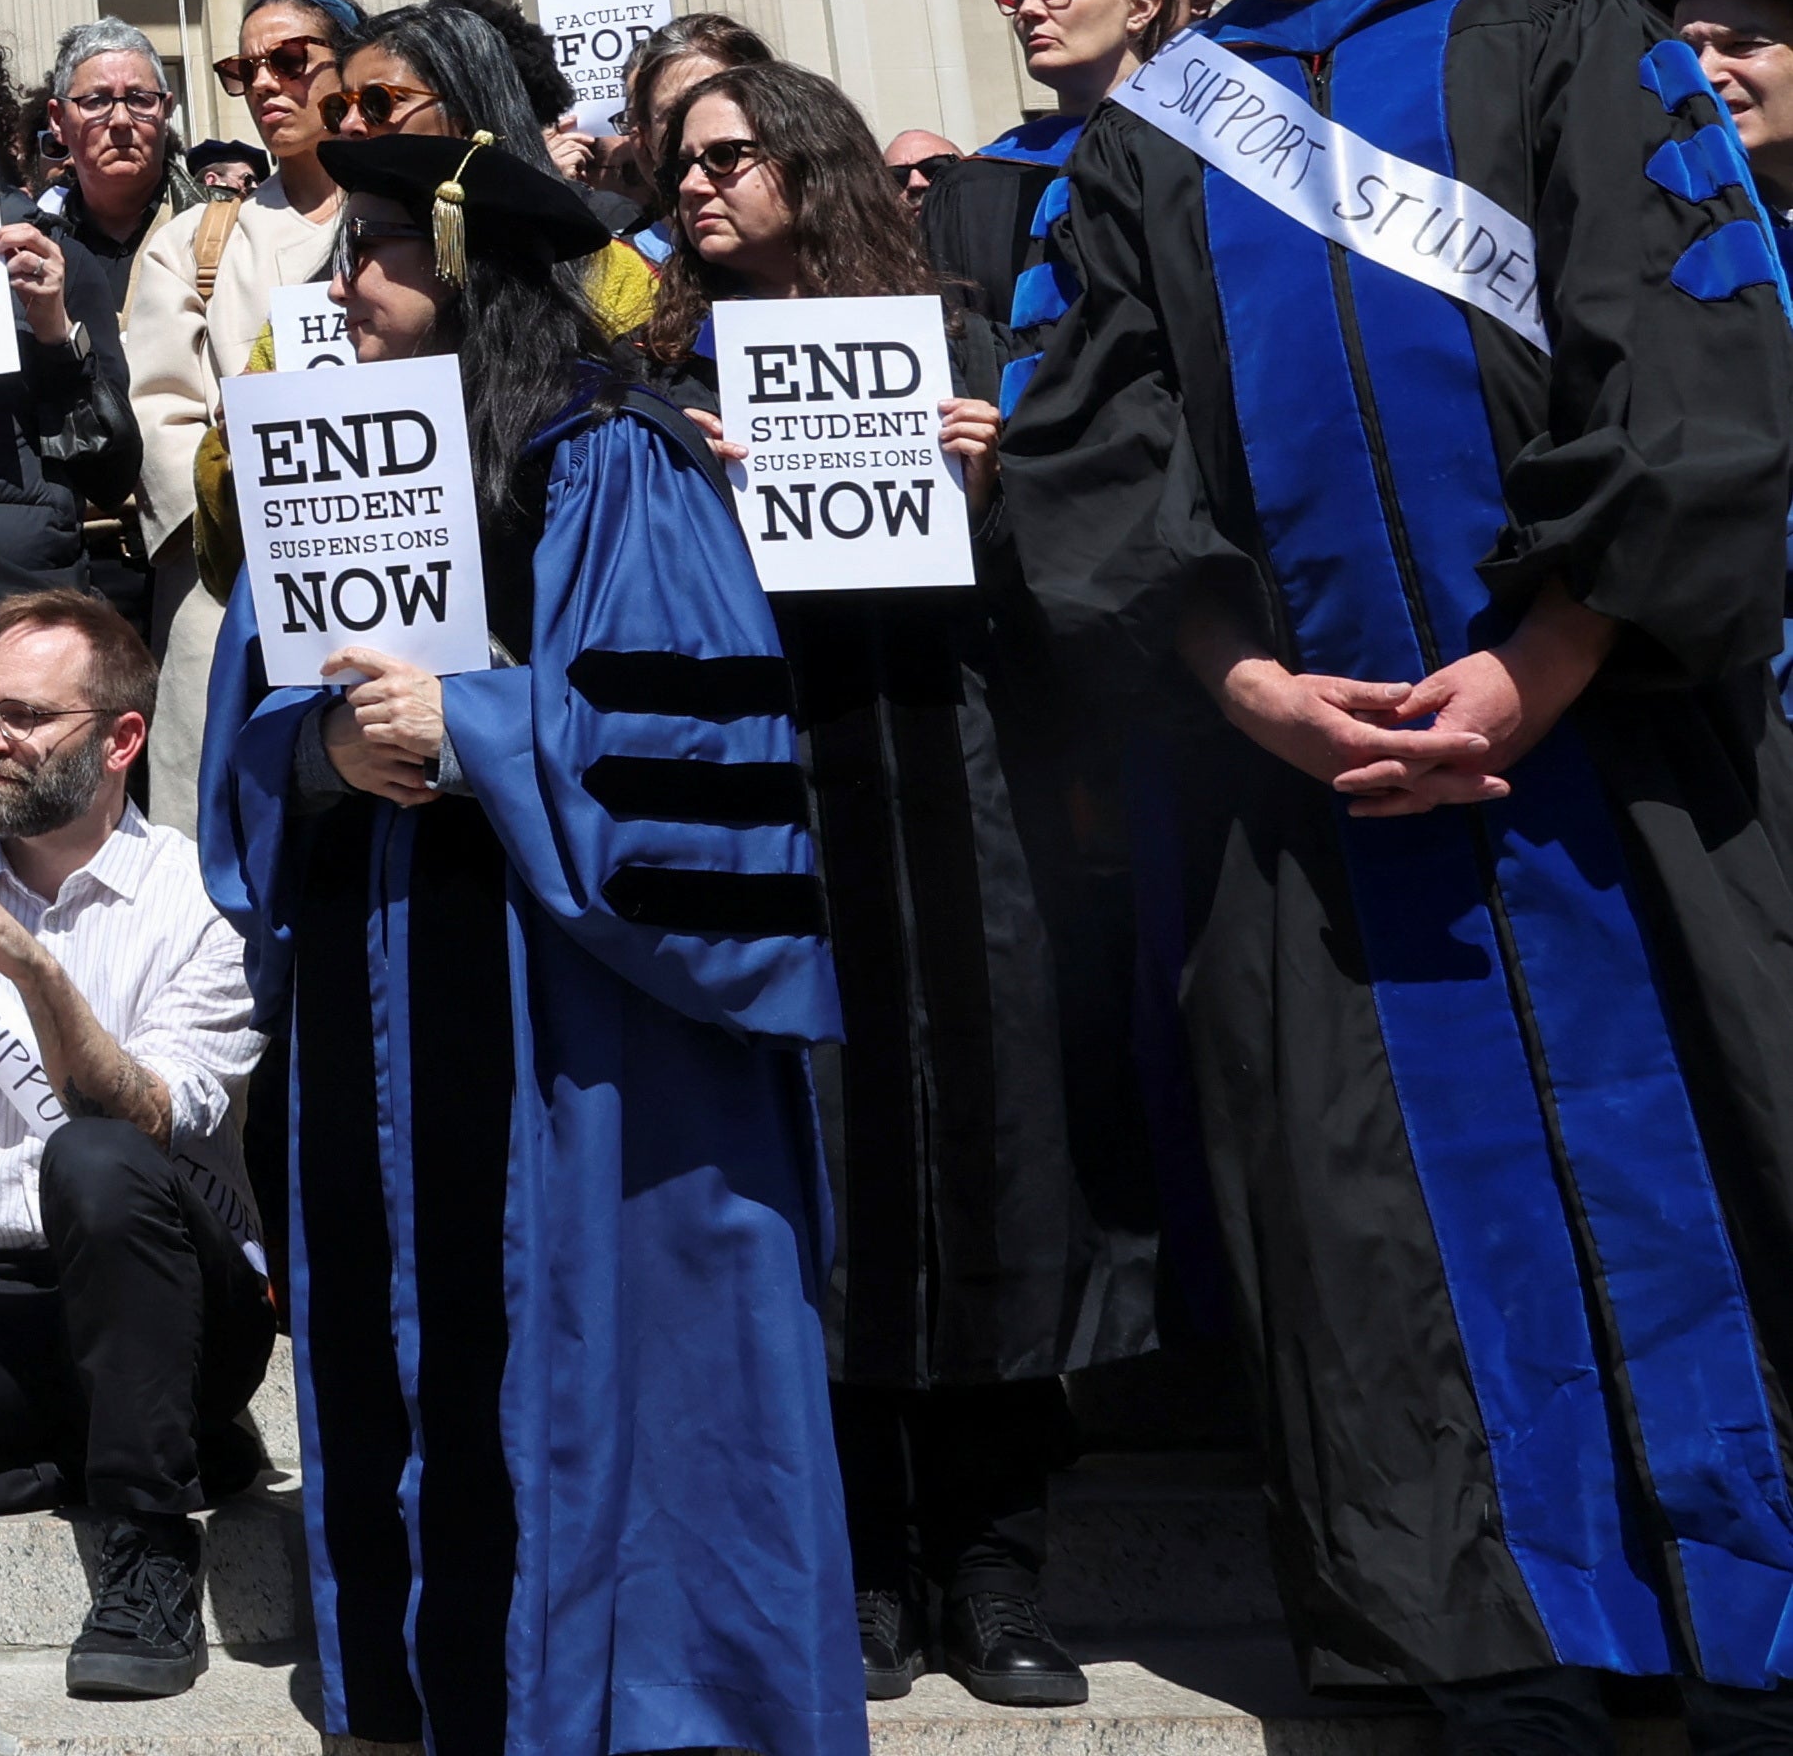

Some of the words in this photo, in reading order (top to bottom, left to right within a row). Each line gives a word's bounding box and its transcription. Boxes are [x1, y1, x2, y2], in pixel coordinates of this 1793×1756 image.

[555, 4, 655, 31] FACULTY
[563, 65, 624, 84] ACADE
[1159, 58, 1326, 190] SUPPORT
[743, 341, 922, 405] END
[750, 410, 928, 442] STUDENT
[251, 408, 437, 488] END
[753, 447, 933, 472] SUSPENSIONS
[264, 486, 444, 529] STUDENT
[757, 480, 935, 542] NOW
[269, 527, 450, 560] SUSPENSIONS
[274, 560, 452, 633] NOW
